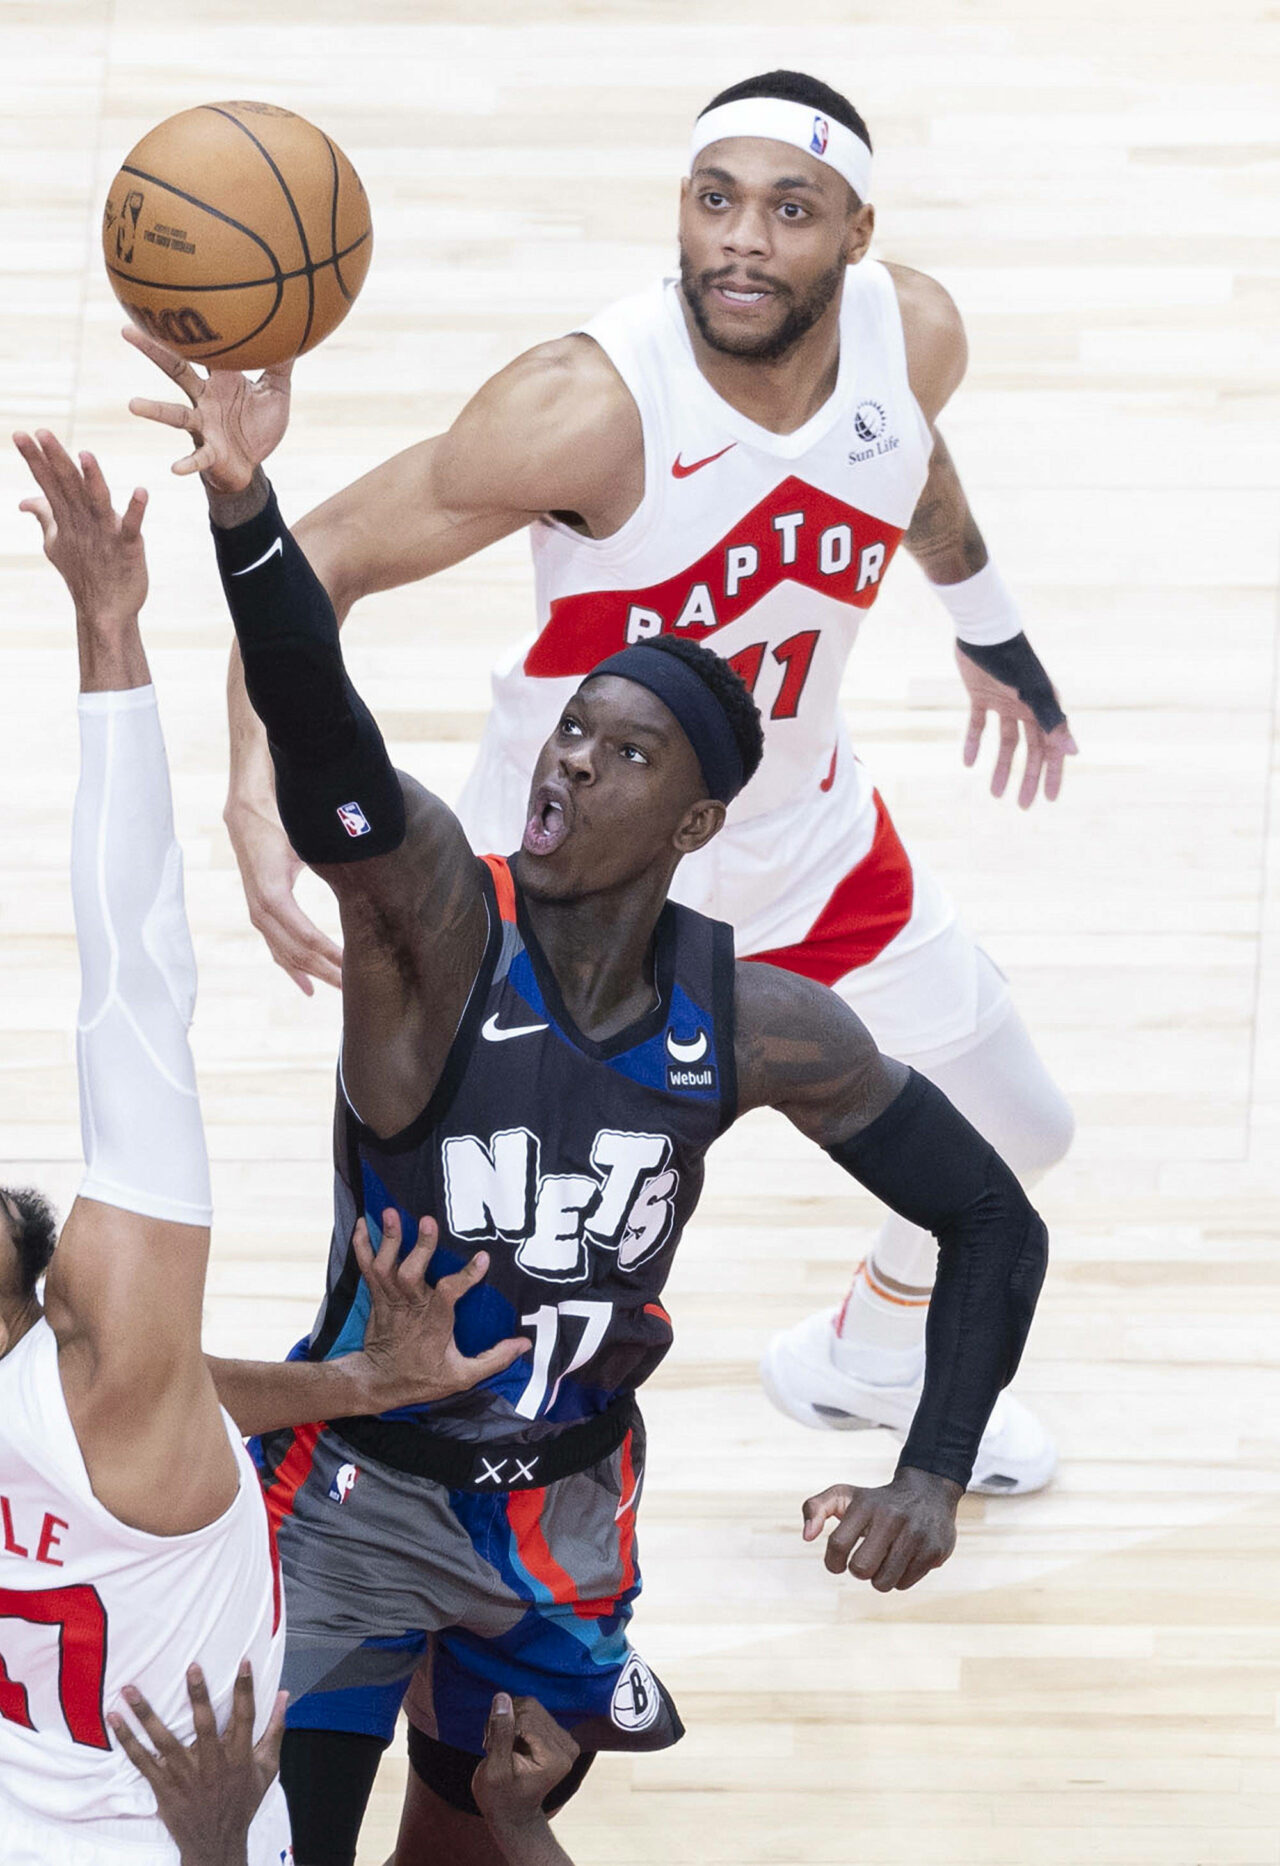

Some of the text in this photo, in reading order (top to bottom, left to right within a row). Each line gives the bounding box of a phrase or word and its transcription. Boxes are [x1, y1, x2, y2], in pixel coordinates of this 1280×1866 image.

[848, 434, 900, 466] Sun Life
[669, 1070, 712, 1086] Webull
[441, 1126, 679, 1284] NETS
[515, 1300, 614, 1421] 17
[629, 1667, 649, 1715] B
